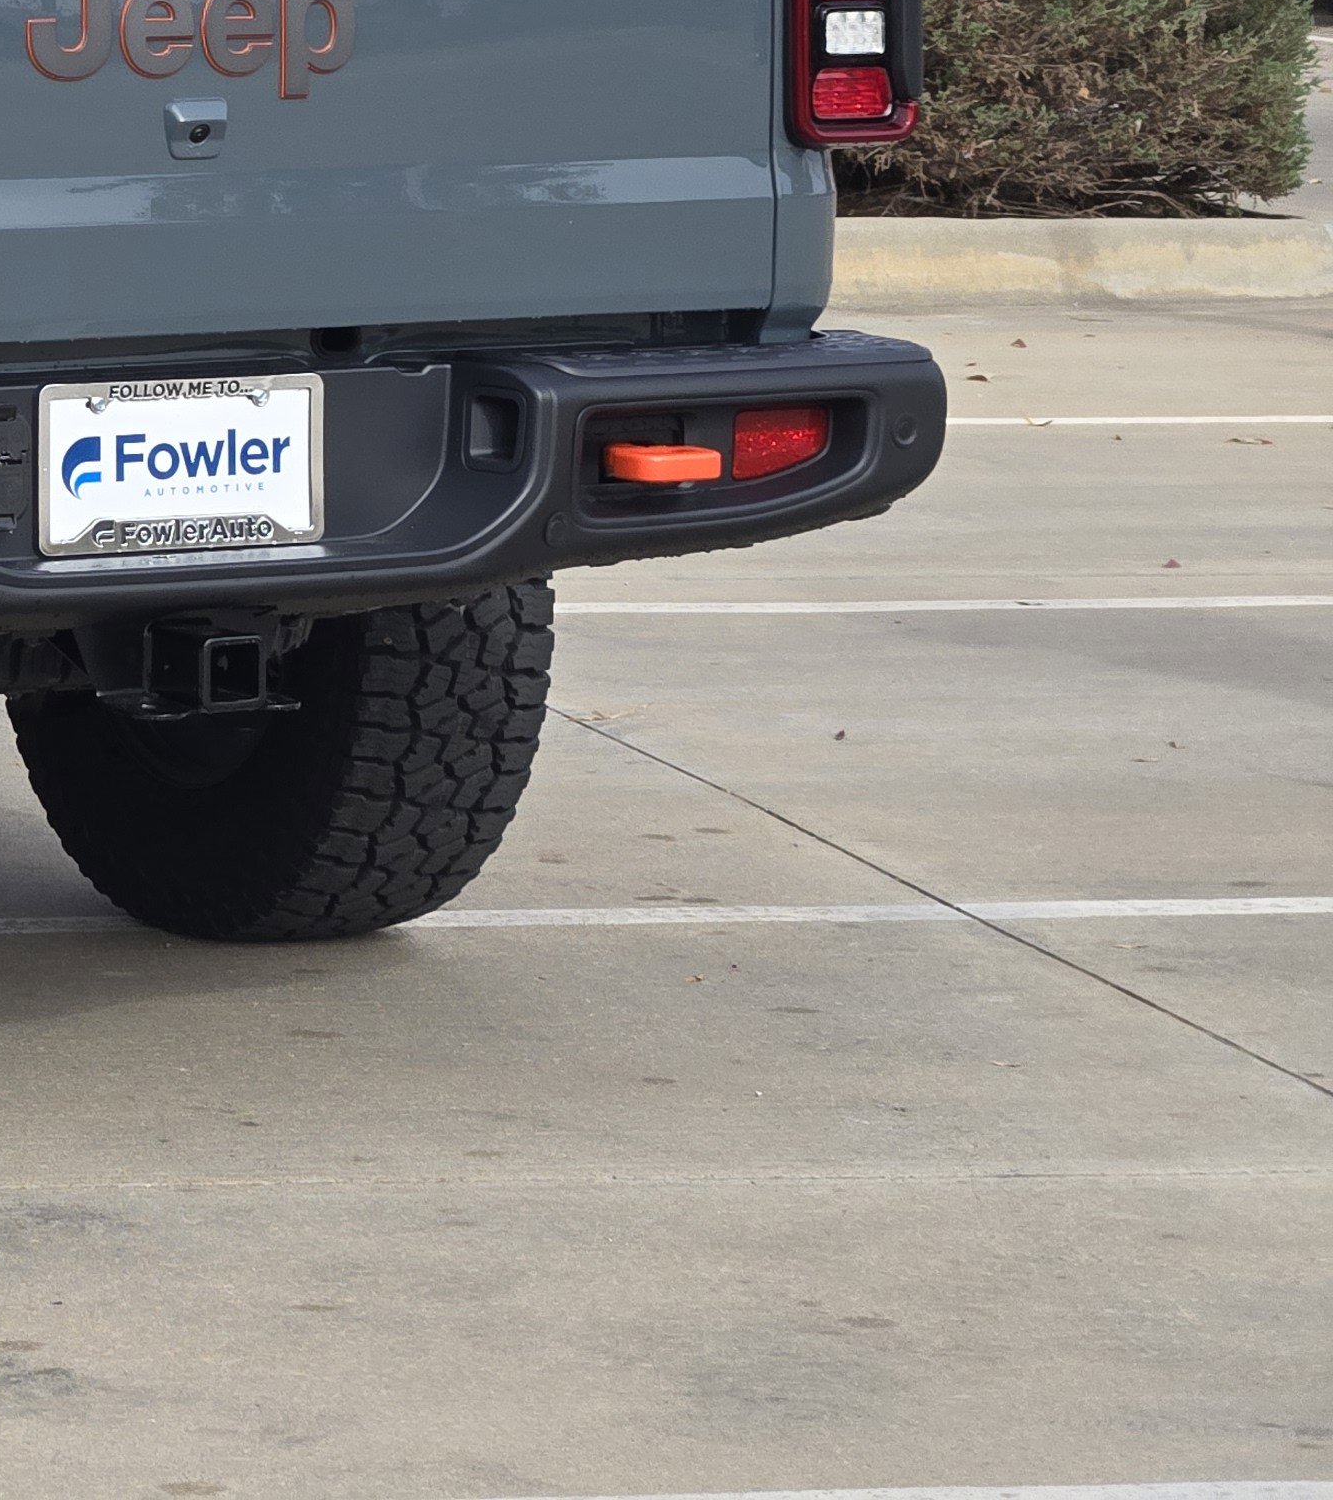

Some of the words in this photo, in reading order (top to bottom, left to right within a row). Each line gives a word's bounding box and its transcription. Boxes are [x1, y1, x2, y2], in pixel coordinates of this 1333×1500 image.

[108, 382, 183, 399] FOLLOW
[188, 381, 213, 396] ME
[115, 428, 291, 482] Fowler
[144, 482, 265, 497] AUTOMOTIVE
[119, 516, 274, 546] FowlerAuto
